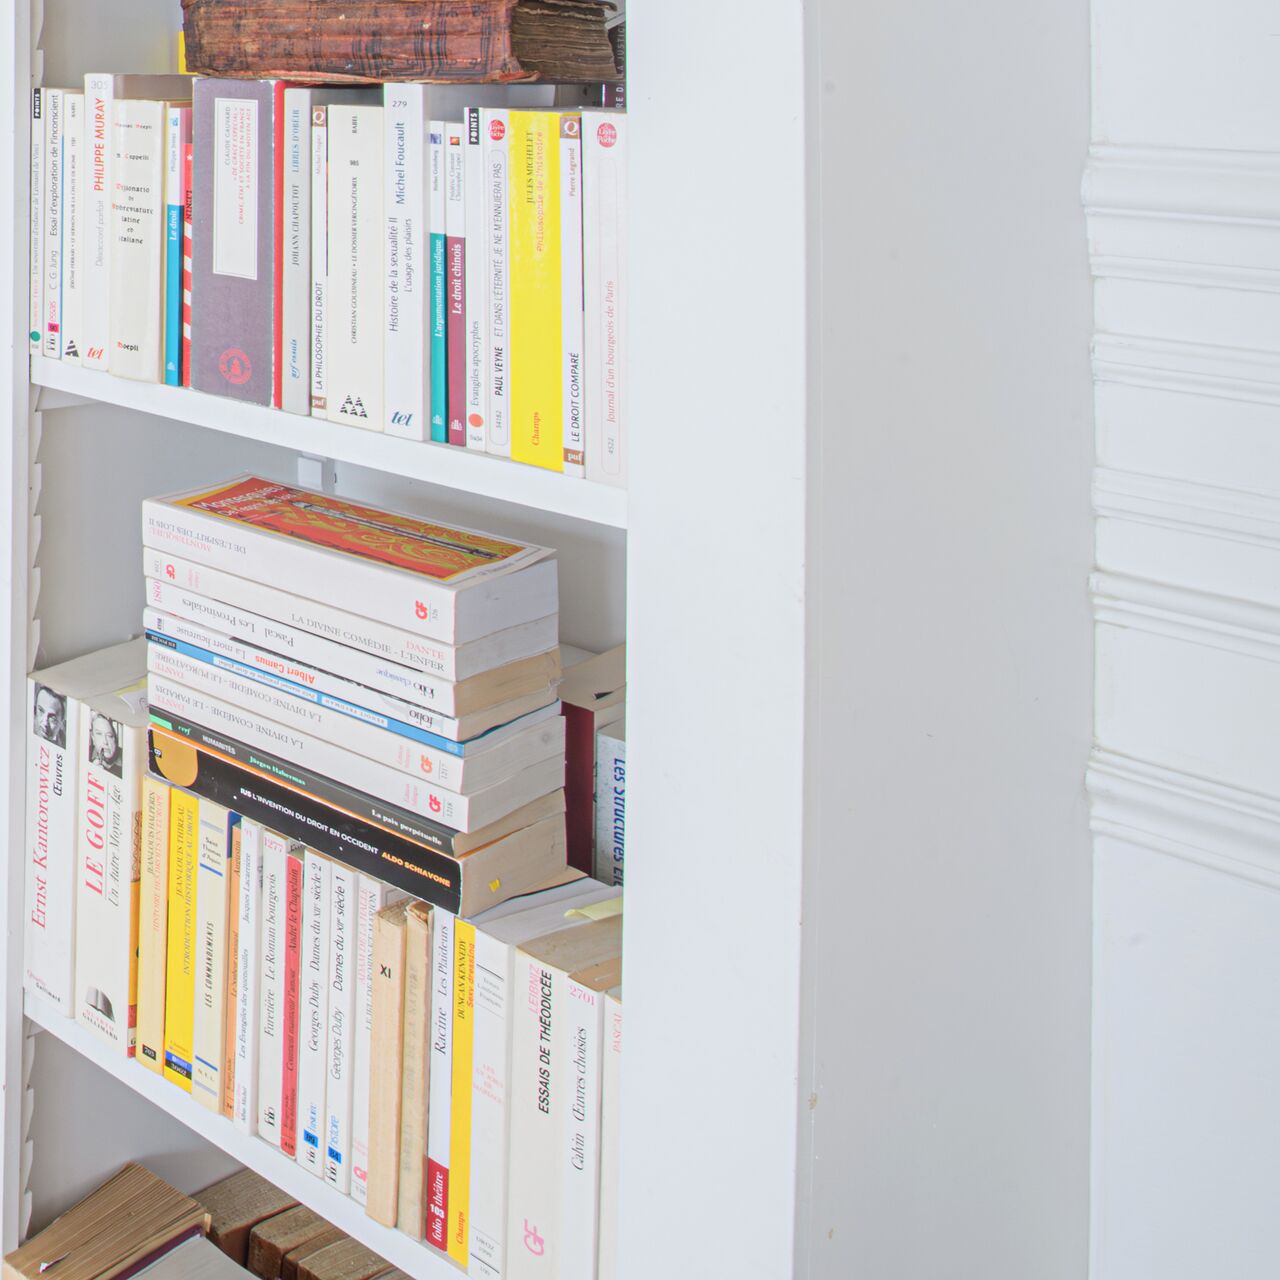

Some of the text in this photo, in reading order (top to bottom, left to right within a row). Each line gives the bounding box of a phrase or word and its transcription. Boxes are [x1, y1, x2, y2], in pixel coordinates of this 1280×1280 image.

[391, 100, 407, 109] 279
[94, 98, 105, 191] PHILIPPE MURAY
[469, 112, 478, 142] POINTS
[49, 95, 59, 236] Essai d'exploration de l'inconscient
[394, 122, 406, 204] Michel Foucault
[492, 163, 502, 178] PAS
[568, 148, 577, 197] Pierre Legrand
[492, 180, 502, 233] M'ENNUIERAI
[169, 210, 177, 240] Le droit
[493, 236, 502, 247] NE
[388, 226, 399, 267] sexualité
[402, 218, 414, 292] L'usage des plaisirs
[493, 249, 502, 257] JE
[388, 270, 399, 278] la
[388, 281, 399, 293] de
[433, 239, 445, 337] L'argumentation juridique
[451, 244, 462, 314] Le droit chinois
[491, 259, 503, 303] L'ÉTERNITÉ
[388, 296, 399, 332] Histoire
[494, 306, 503, 329] DANS
[87, 346, 104, 360] tel
[315, 282, 323, 390] LA PHILOSOPHIE DU DROIT
[604, 281, 617, 423] Journal d'un bourgeois de Paris
[493, 346, 503, 396] PAUL VEYNE
[568, 352, 580, 442] LE DROIT COMPARÉ
[391, 412, 413, 426] tel
[531, 411, 541, 446] Champs
[182, 598, 256, 633] Les Provinciales
[415, 600, 427, 620] GF
[176, 627, 246, 660] La mort heureuse
[264, 628, 294, 647] Pascal
[306, 619, 341, 636] DIVINE
[342, 629, 391, 654] COMÉDIE
[400, 649, 445, 672] L'ENFER
[405, 641, 444, 659] DANTE
[211, 672, 222, 682] LE
[255, 655, 315, 684] Albert Camus
[229, 678, 272, 703] COMÉDIE
[274, 696, 305, 716] DIVINE
[155, 685, 304, 749] LA DIVINE COMÉDIE LE PARADIS
[307, 709, 322, 722] LA
[409, 709, 433, 729] folio
[53, 754, 63, 797] Œuvres
[421, 755, 433, 773] GF
[429, 794, 441, 813] GF
[31, 745, 51, 929] Ernst Kantorowicz
[85, 771, 105, 895] LE GOFF
[252, 793, 294, 817] L'INVENTION
[295, 812, 306, 822] DU
[306, 817, 329, 832] DROIT
[329, 825, 340, 837] EN
[341, 829, 379, 855] OCCIDENT
[381, 851, 404, 866] ALDO
[404, 859, 451, 888] SCHIAVONE
[372, 809, 442, 845] La paix perpétuelle
[204, 921, 214, 990] COMMANDEMENTS
[264, 874, 278, 1037] Furetière Le Roman bourgeois
[380, 963, 392, 979] XI
[434, 925, 449, 1055] Racine Les Plaideurs
[457, 938, 467, 1019] DUNCAN KENNEDY
[528, 964, 539, 1014] LEIBNIZ
[569, 984, 595, 1007] 2701
[538, 969, 553, 1114] ESSAIS DE THÉODICÉE
[571, 1026, 588, 1170] Calvin Œuvres choisies
[431, 1171, 444, 1207] théâtre
[431, 1218, 443, 1242] folio
[456, 1211, 466, 1245] Champs
[524, 1219, 545, 1257] GF
